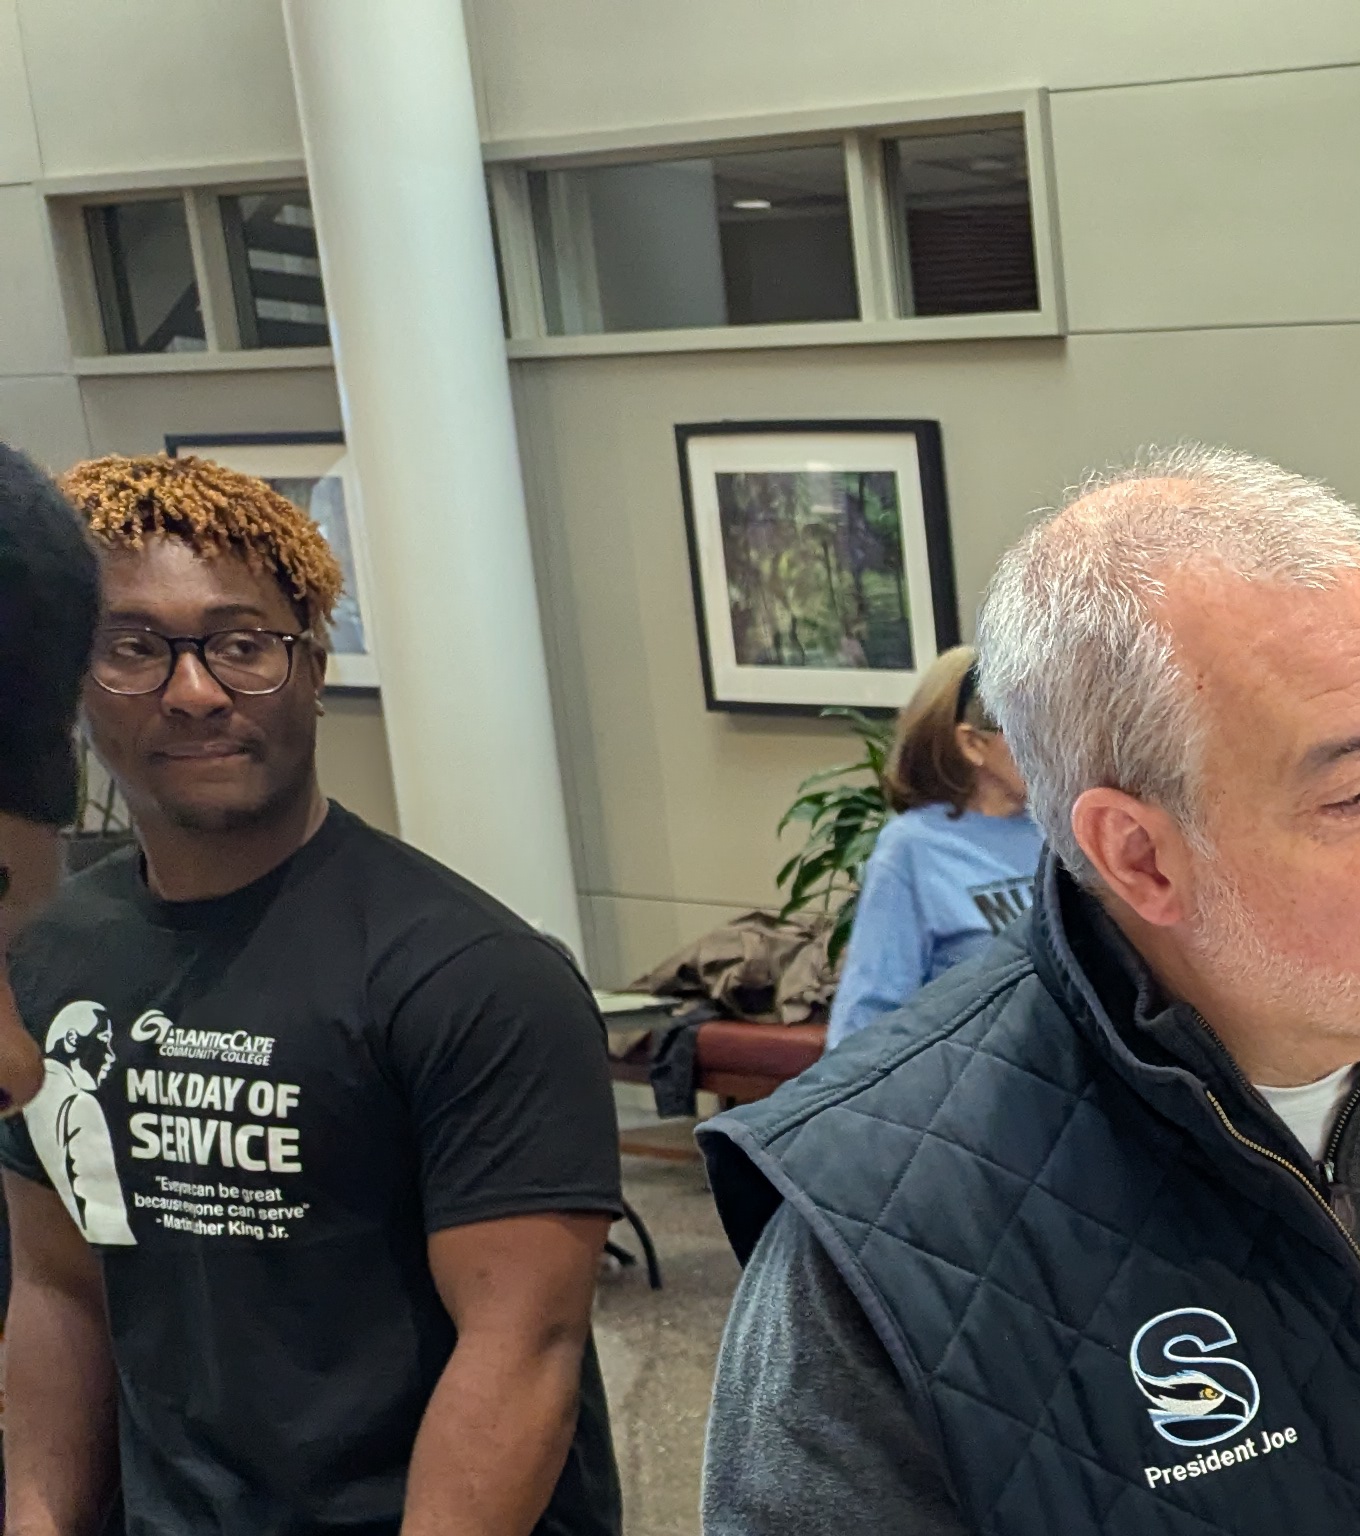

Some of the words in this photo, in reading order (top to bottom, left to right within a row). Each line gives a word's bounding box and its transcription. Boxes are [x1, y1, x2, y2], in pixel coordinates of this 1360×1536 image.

[159, 1044, 220, 1061] COMMUNITY
[220, 1050, 272, 1067] COLLEGE
[126, 1067, 185, 1107] MLK
[184, 1072, 246, 1112] DAY
[247, 1080, 301, 1118] OF
[129, 1111, 303, 1173] SERVICE
[218, 1182, 240, 1199] be
[242, 1187, 282, 1203] great
[227, 1203, 256, 1219] can
[228, 1220, 264, 1241] King
[267, 1223, 290, 1239] Jr.
[1144, 1440, 1259, 1490] President
[1260, 1423, 1299, 1459] Joe
